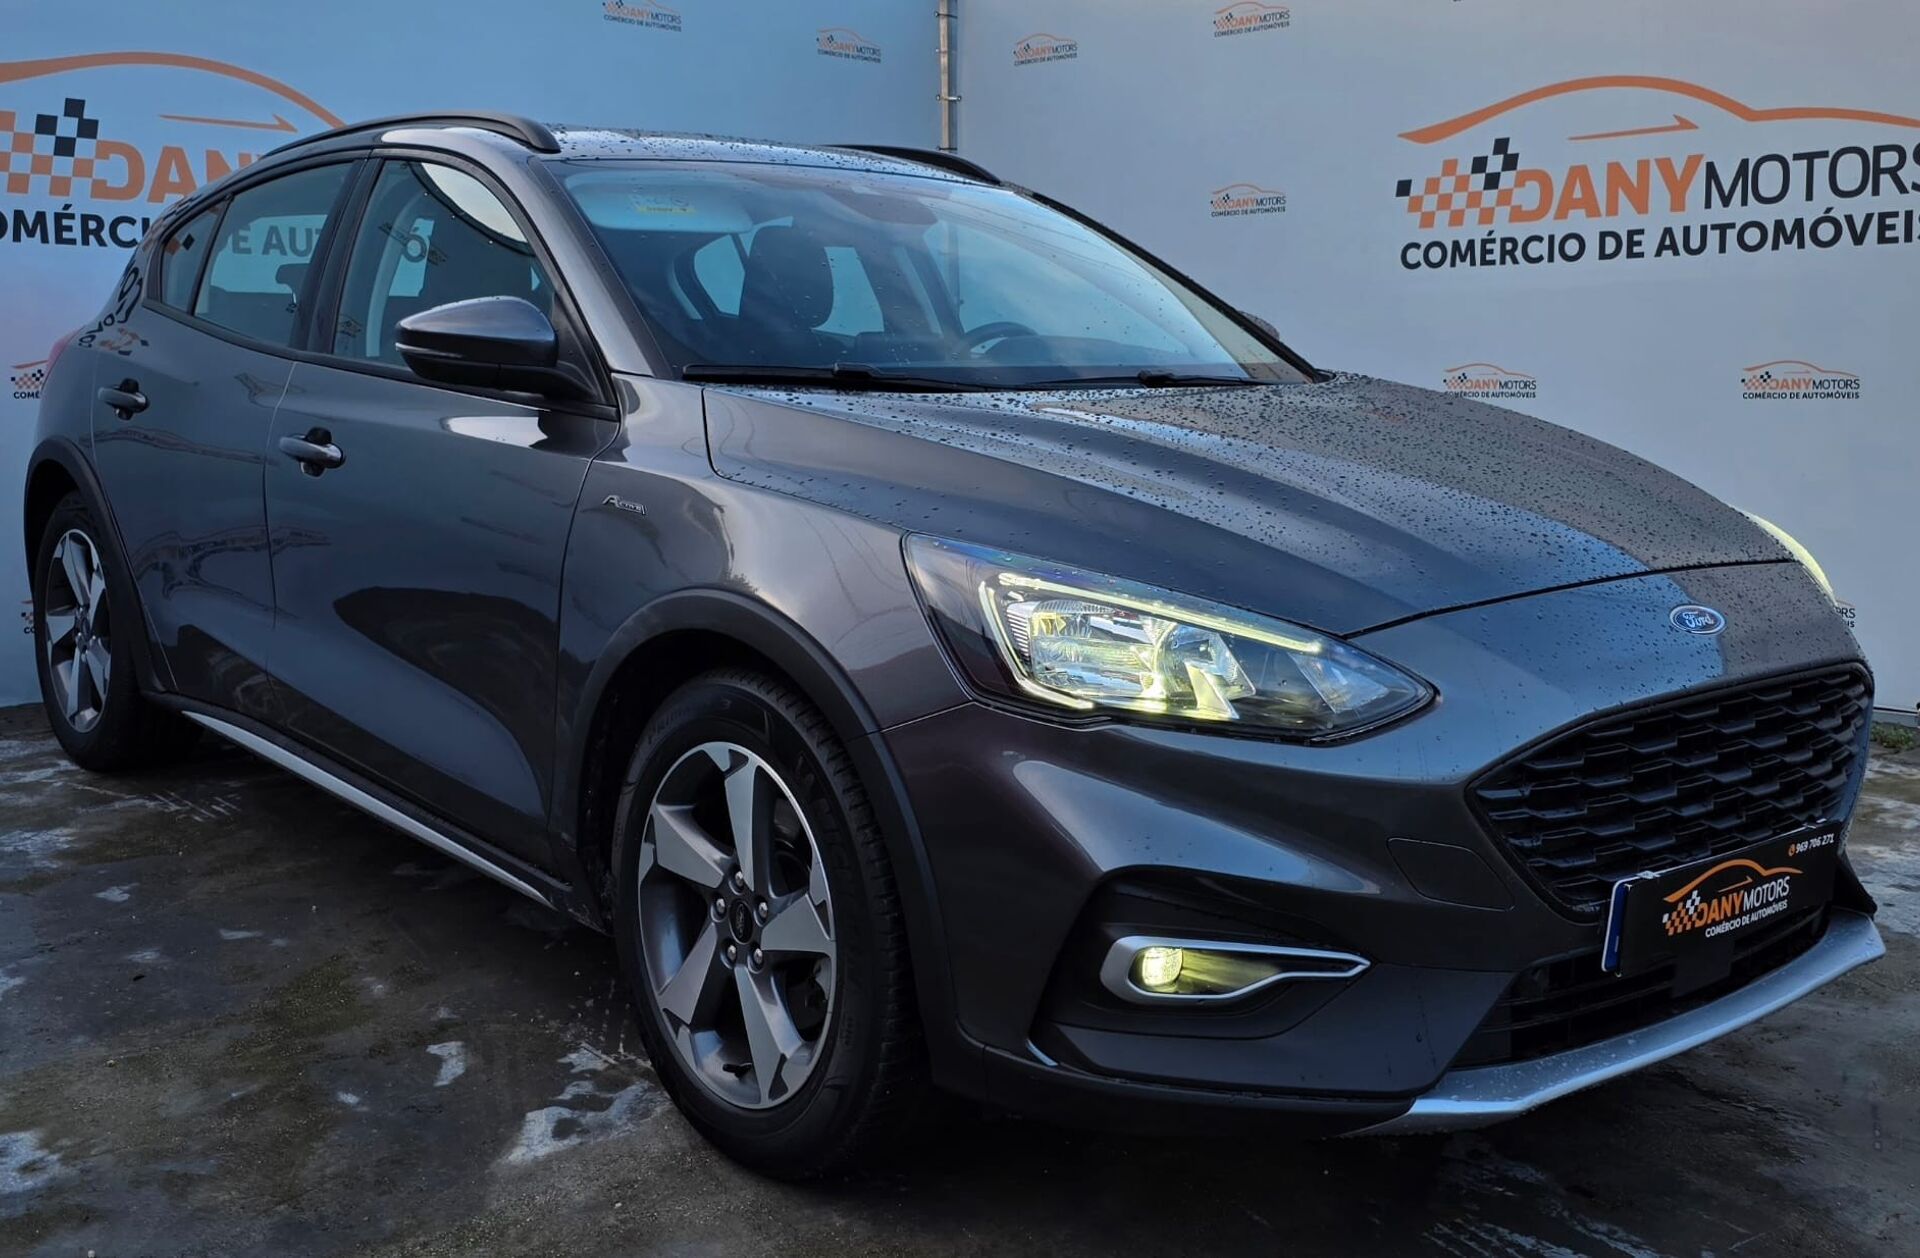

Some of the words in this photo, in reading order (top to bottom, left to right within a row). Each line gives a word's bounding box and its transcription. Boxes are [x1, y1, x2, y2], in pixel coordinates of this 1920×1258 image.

[1400, 230, 1586, 270] COMÉRCIO
[1597, 228, 1645, 261] DE
[1654, 206, 1920, 259] AUTOMÓVEI
[1742, 391, 1788, 399] COMÉRCIO
[1682, 611, 1715, 628] Ford
[1705, 918, 1741, 938] COMÉRCIO
[1741, 914, 1750, 926] DE
